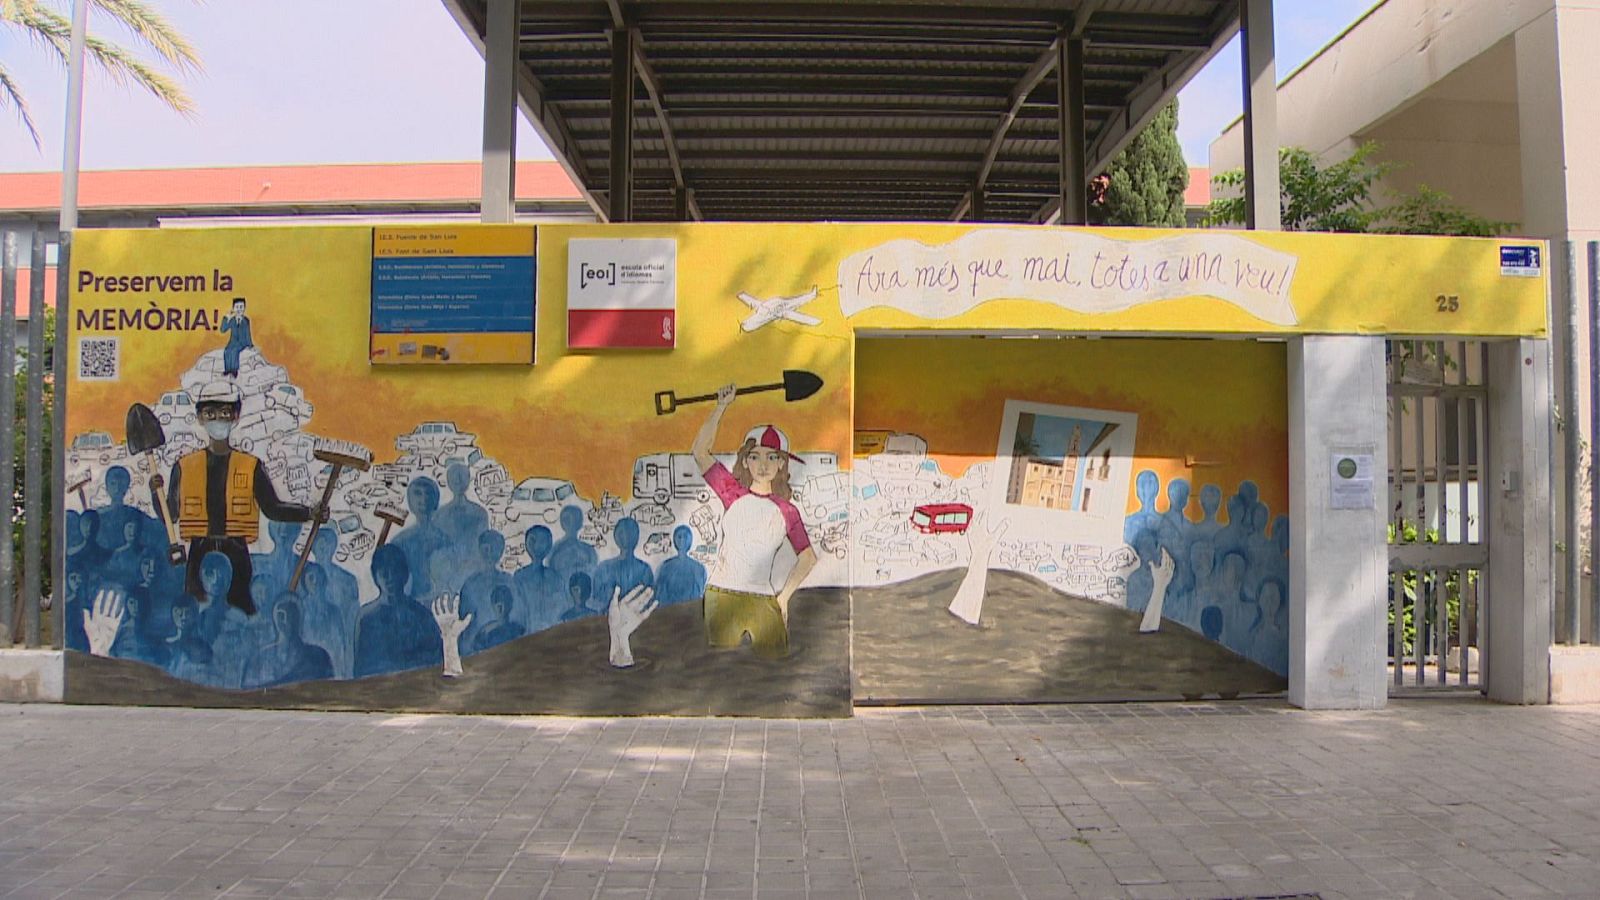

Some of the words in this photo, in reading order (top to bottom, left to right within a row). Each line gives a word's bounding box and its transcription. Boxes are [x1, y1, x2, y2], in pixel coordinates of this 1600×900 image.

[77, 270, 206, 293] Preservem
[213, 268, 233, 292] la
[857, 255, 907, 296] Ara
[915, 260, 960, 292] més
[968, 258, 1008, 297] que
[1090, 251, 1150, 292] totes
[1153, 259, 1170, 282] a
[1234, 258, 1289, 296] veu!
[76, 301, 219, 332] MEMÒRIA!
[1435, 294, 1459, 312] 25
